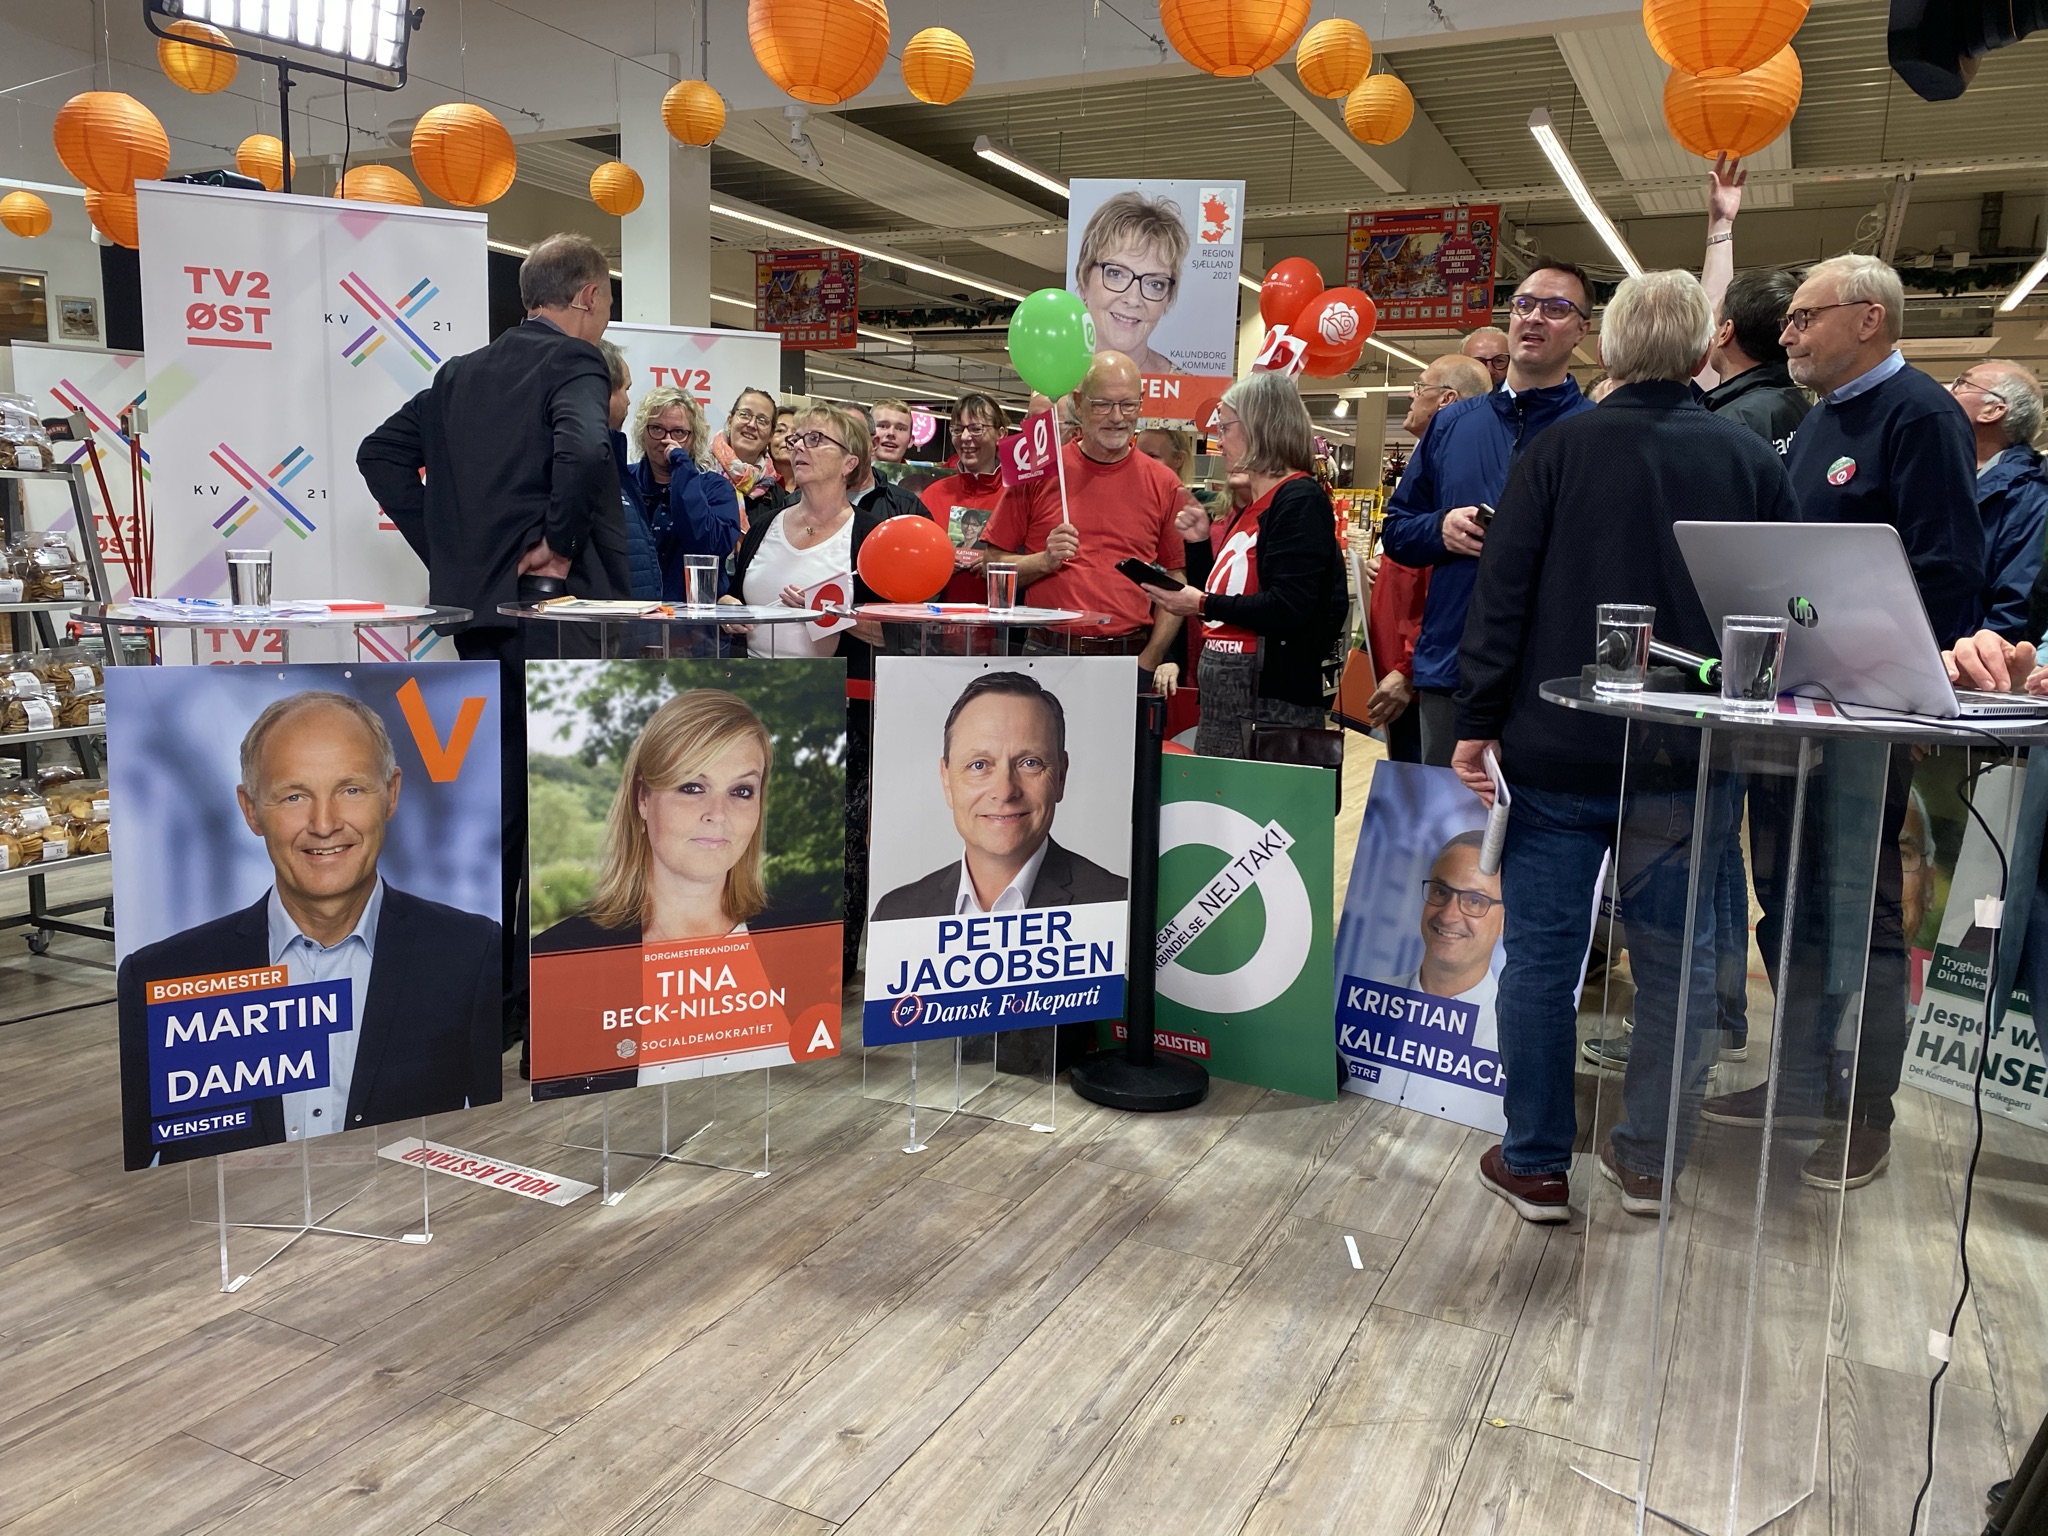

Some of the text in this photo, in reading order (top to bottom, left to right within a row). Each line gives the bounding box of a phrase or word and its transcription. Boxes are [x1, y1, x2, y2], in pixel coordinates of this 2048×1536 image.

[1192, 260, 1234, 269] SJÆLLAND
[1202, 249, 1234, 258] REGION
[184, 266, 270, 299] TV2
[1212, 271, 1232, 280] 2021
[186, 302, 271, 334] ØST
[1170, 349, 1227, 361] KALUNDBORG
[1182, 361, 1227, 371] KOMMUNE
[649, 366, 711, 391] TV2
[1794, 597, 1813, 628] hp
[204, 629, 282, 652] TV2
[396, 677, 487, 783] V
[1198, 828, 1287, 917] NEJ TAK!
[938, 910, 1074, 954] PETER
[644, 942, 751, 963] BORGMESTERKANDIDAT
[886, 940, 1114, 995] JACOBSEN
[153, 970, 282, 1000] BORGMESTER
[656, 963, 738, 998] TINA
[1937, 968, 1958, 983] Din
[1960, 973, 1987, 991] loka
[165, 993, 338, 1047] MARTIN
[602, 987, 786, 1031] BECK-NILSSON
[900, 1005, 915, 1017] DF
[922, 984, 1102, 1025] Dansk Folkeparti
[1346, 985, 1468, 1036] KRISTIAN
[641, 1023, 774, 1052] SOCIALDEMOKRATIET
[806, 1019, 835, 1054] A
[167, 1050, 316, 1103] DAMM
[1350, 1064, 1378, 1079] STRE
[1915, 1030, 2048, 1099] HANSE
[1908, 1064, 1924, 1076] Det
[1984, 1087, 2033, 1111] Folkeparti
[158, 1112, 247, 1138] VENSTRE
[401, 1148, 561, 1197] HOLD AFSTAND
